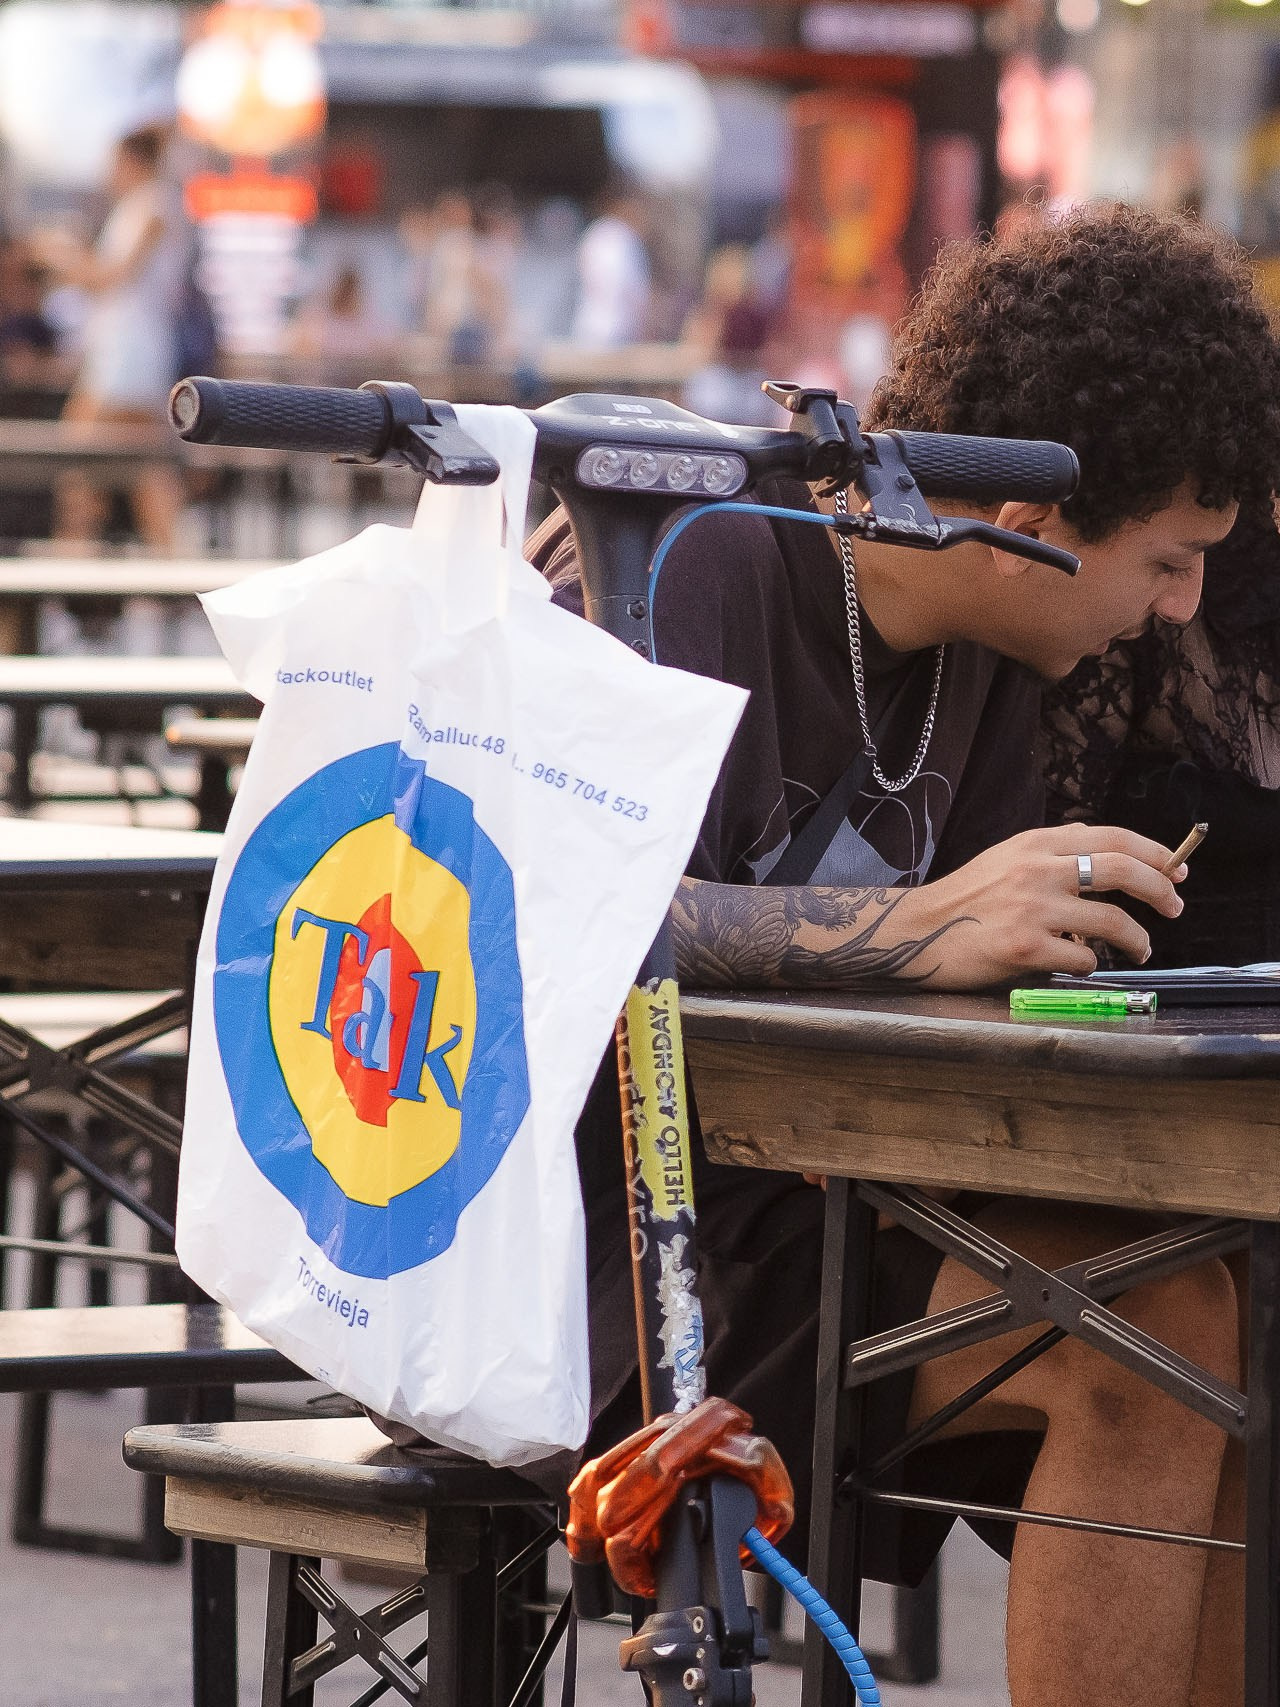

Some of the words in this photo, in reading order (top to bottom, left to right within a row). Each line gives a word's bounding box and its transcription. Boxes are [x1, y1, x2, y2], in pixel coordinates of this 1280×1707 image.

[481, 736, 505, 754] 48
[532, 763, 568, 788] 965
[573, 778, 607, 804] 704
[612, 797, 648, 821] 523
[290, 907, 463, 1112] Tak
[659, 1125, 686, 1206] HELLO
[297, 1256, 369, 1328] Torrevieja
